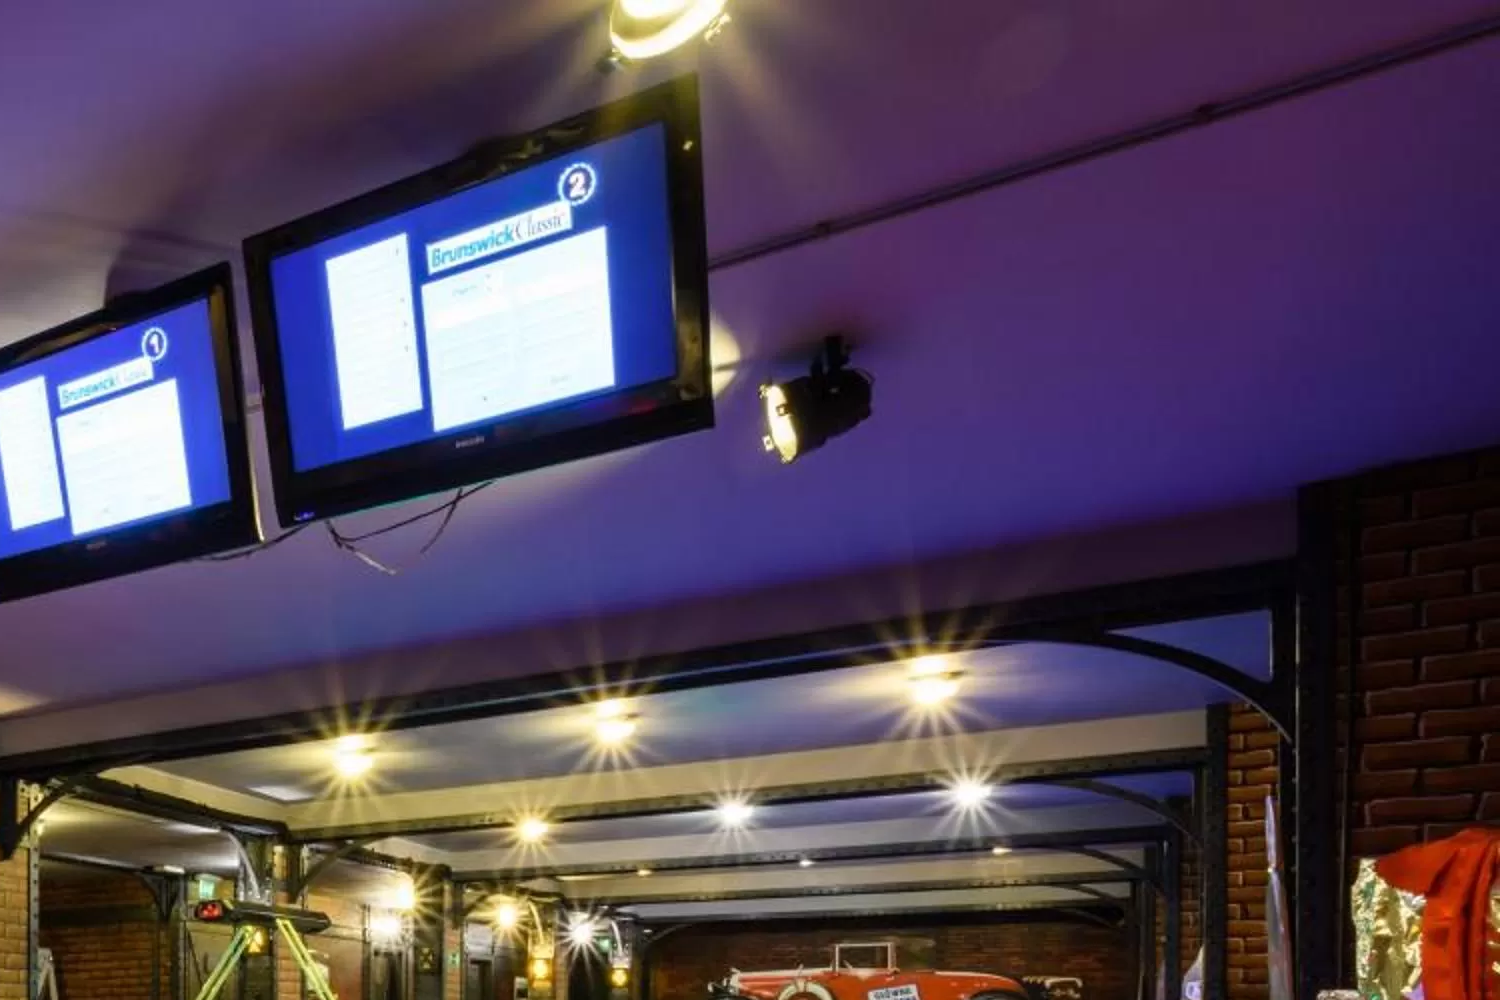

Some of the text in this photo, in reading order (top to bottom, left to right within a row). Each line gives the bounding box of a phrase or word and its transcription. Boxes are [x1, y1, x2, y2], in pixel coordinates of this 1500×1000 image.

[569, 172, 586, 198] 2
[431, 225, 514, 268] Brunswick
[149, 333, 160, 354] 1
